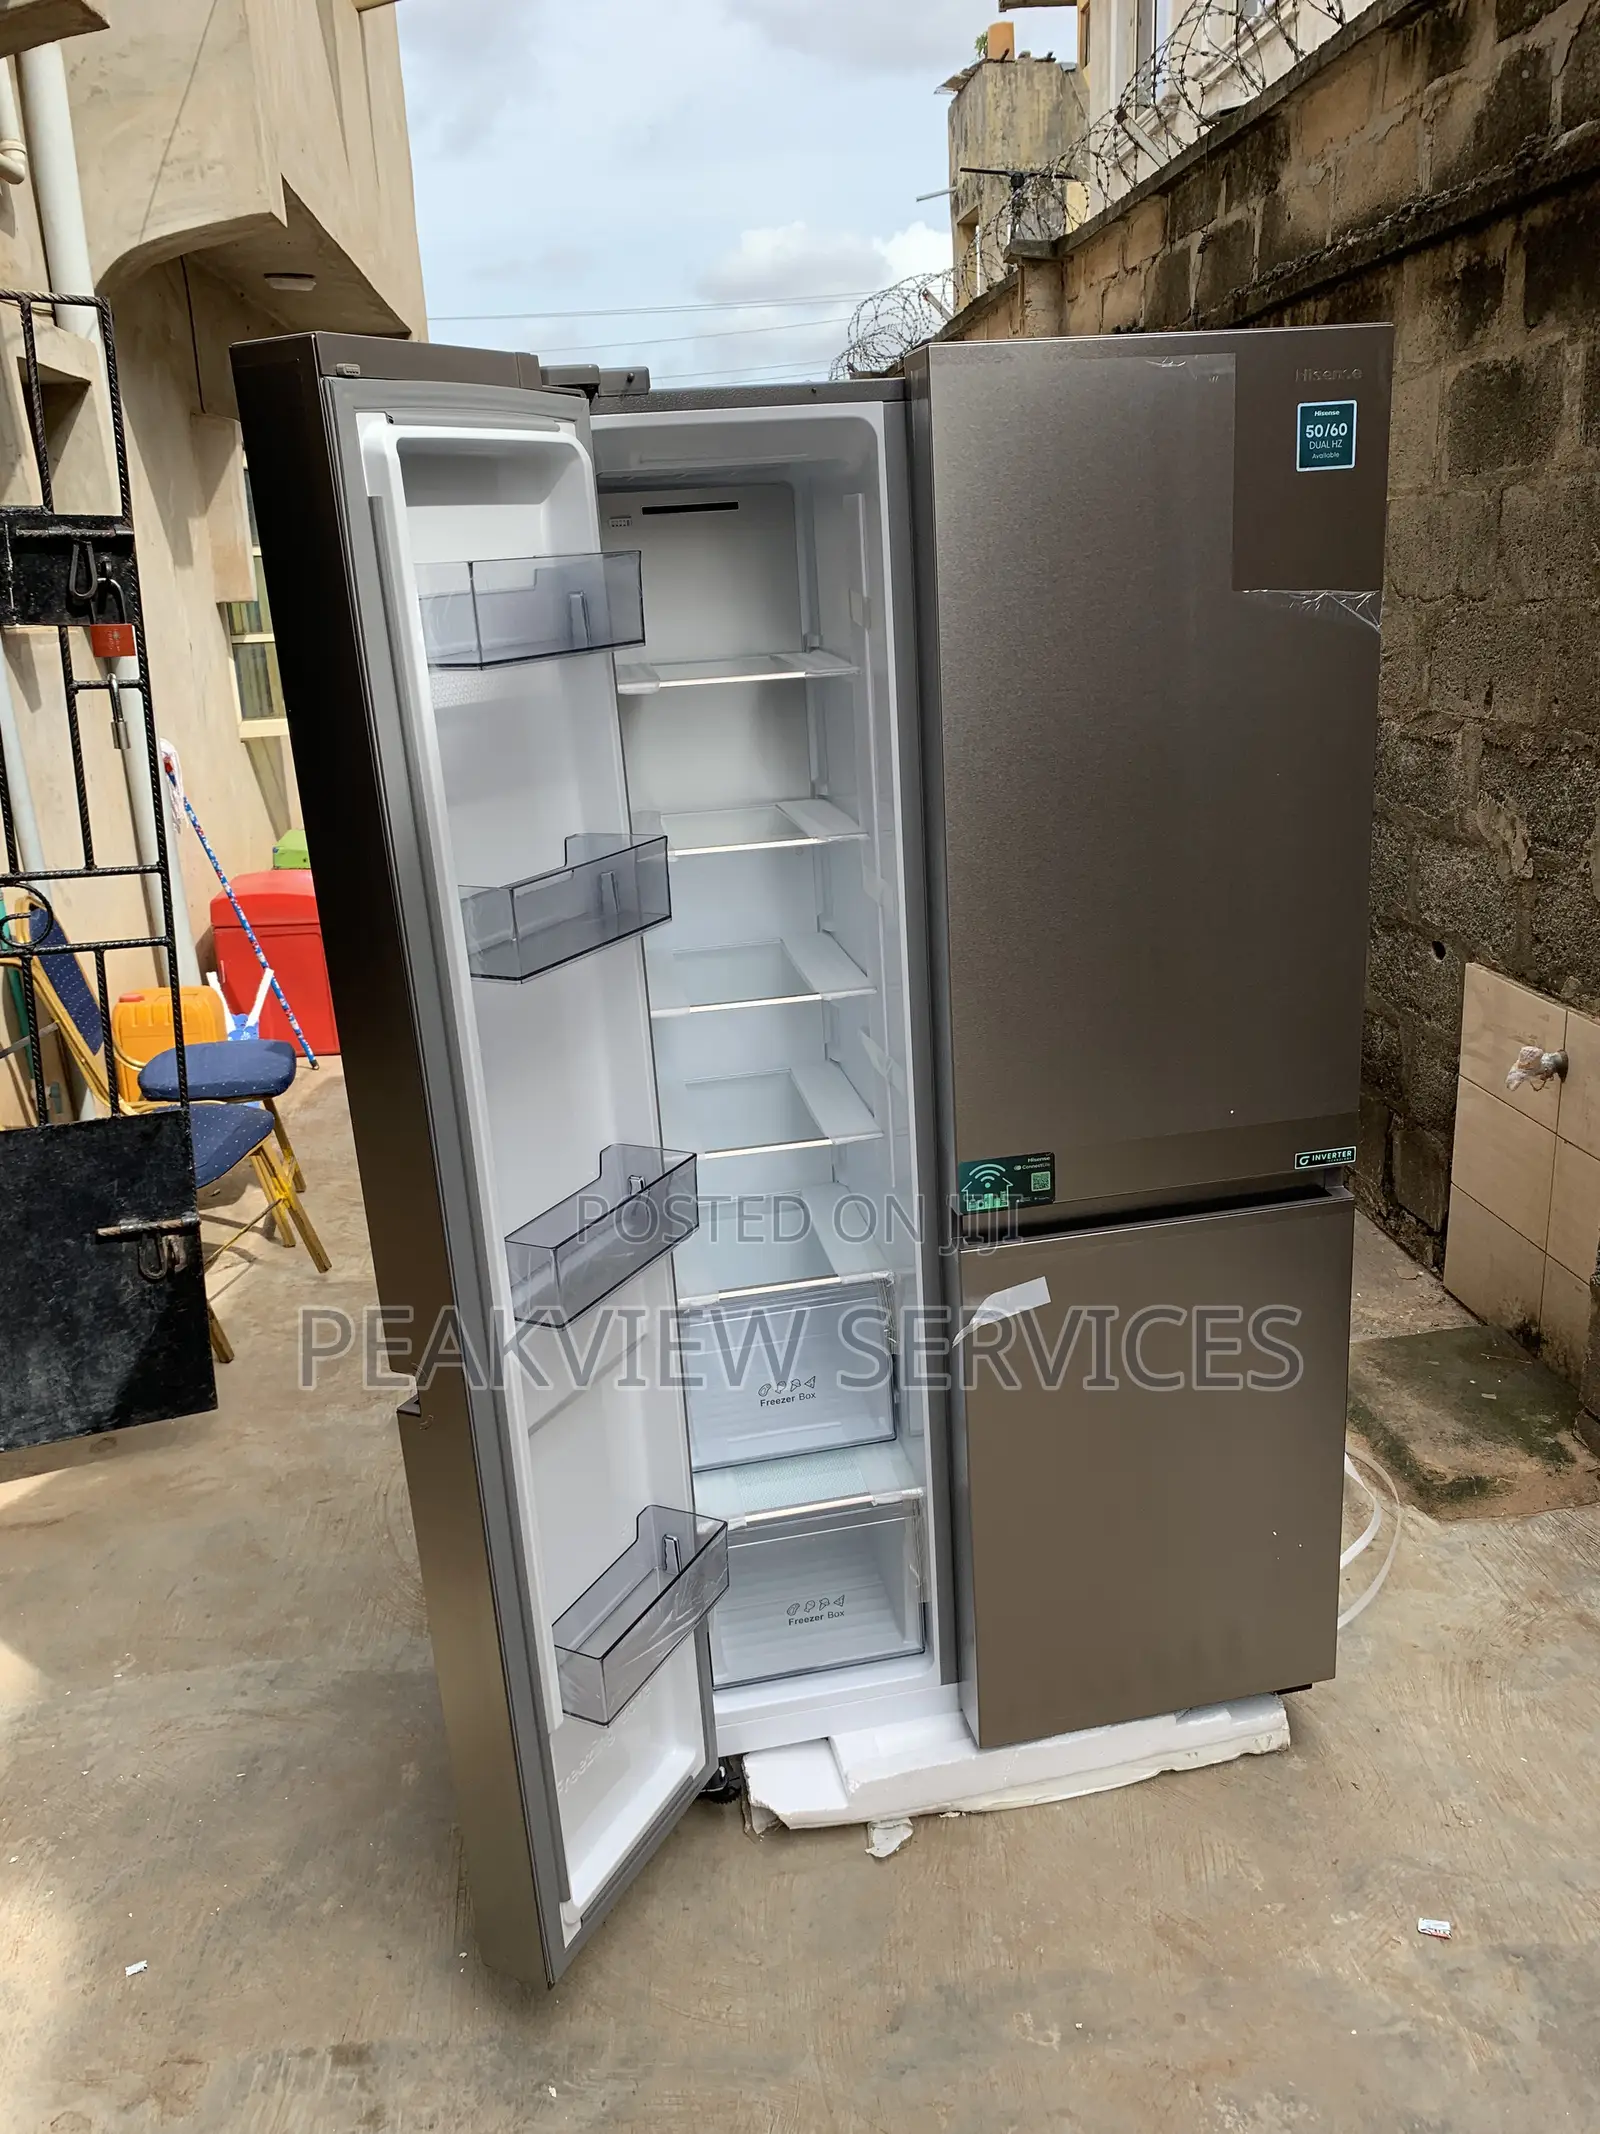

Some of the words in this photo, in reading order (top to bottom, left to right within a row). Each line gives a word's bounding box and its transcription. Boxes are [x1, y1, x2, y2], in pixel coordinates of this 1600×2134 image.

[1295, 368, 1363, 382] Hisense
[1306, 422, 1348, 438] 50/60
[1309, 440, 1330, 450] DUAL
[1332, 439, 1343, 449] HZ
[1312, 1150, 1352, 1161] INVERTER
[760, 1395, 795, 1407] Freezer
[800, 1392, 817, 1401] Box
[788, 1614, 824, 1626] Freezer
[828, 1610, 845, 1619] Box
